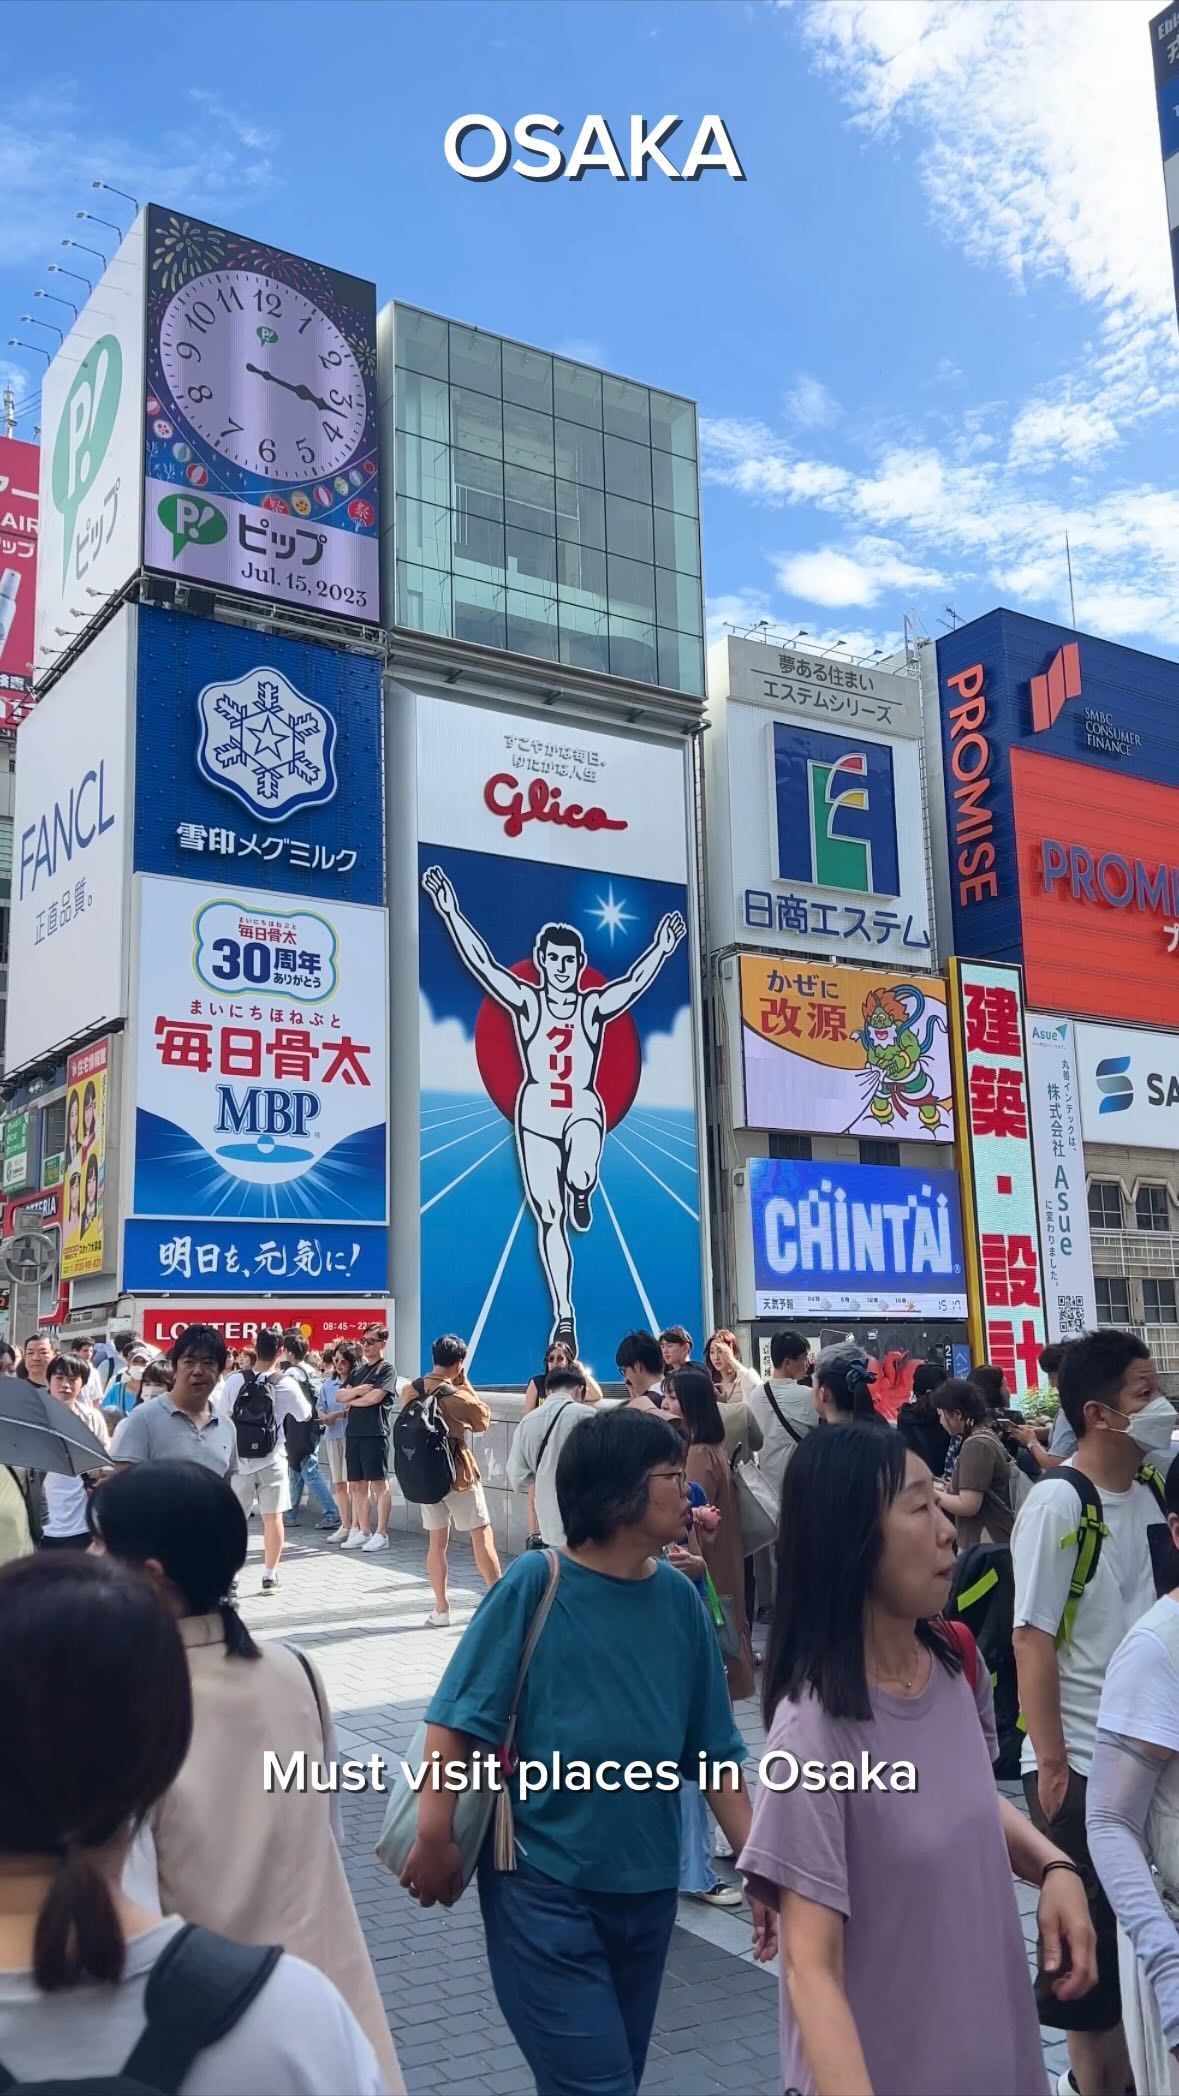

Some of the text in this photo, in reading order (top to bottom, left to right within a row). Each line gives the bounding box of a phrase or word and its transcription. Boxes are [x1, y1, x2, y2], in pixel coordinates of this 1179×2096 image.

[216, 286, 244, 312] 11
[252, 289, 282, 318] 12
[185, 301, 216, 334] 10
[298, 317, 312, 335] 1
[177, 342, 202, 363] 9
[319, 350, 342, 370] 2
[188, 384, 213, 403] 8
[330, 389, 354, 408] 3
[220, 418, 244, 439] 7
[323, 421, 343, 443] 4
[259, 439, 277, 463] 6
[296, 439, 315, 464] 5
[76, 477, 121, 580] ピップ
[239, 513, 328, 566] ピップ
[241, 562, 367, 607] Jul. 15, 2023
[778, 654, 874, 691] 夢ある住まい
[763, 680, 892, 724] エステムシリーズ
[1085, 707, 1113, 726] SMBC
[1086, 720, 1143, 747] CONSUMER
[1087, 733, 1132, 756] FINANCE
[947, 664, 998, 906] PROMISE
[484, 773, 628, 838] Glico
[20, 759, 115, 901] FANCL
[176, 822, 357, 872] 雪印メグミルク
[34, 876, 93, 946] 正直品質。
[239, 916, 297, 930] まいにちほねぶと
[744, 888, 931, 949] 日商エステム
[238, 924, 297, 945] 毎日骨太
[212, 938, 322, 984] 30周年
[273, 972, 322, 989] ありがとう
[767, 969, 839, 999] かぜに
[191, 999, 341, 1029] まいにちほねぶと
[760, 998, 850, 1042] 改源
[1032, 1026, 1058, 1040] Asue
[154, 1015, 371, 1087] 毎日骨太
[546, 1024, 575, 1109] グリコ
[214, 1084, 321, 1138] MBP
[1047, 1082, 1073, 1256] 株式会社 Asue
[1045, 1200, 1060, 1287] に変わりました。
[763, 1298, 794, 1310] 天気予報
